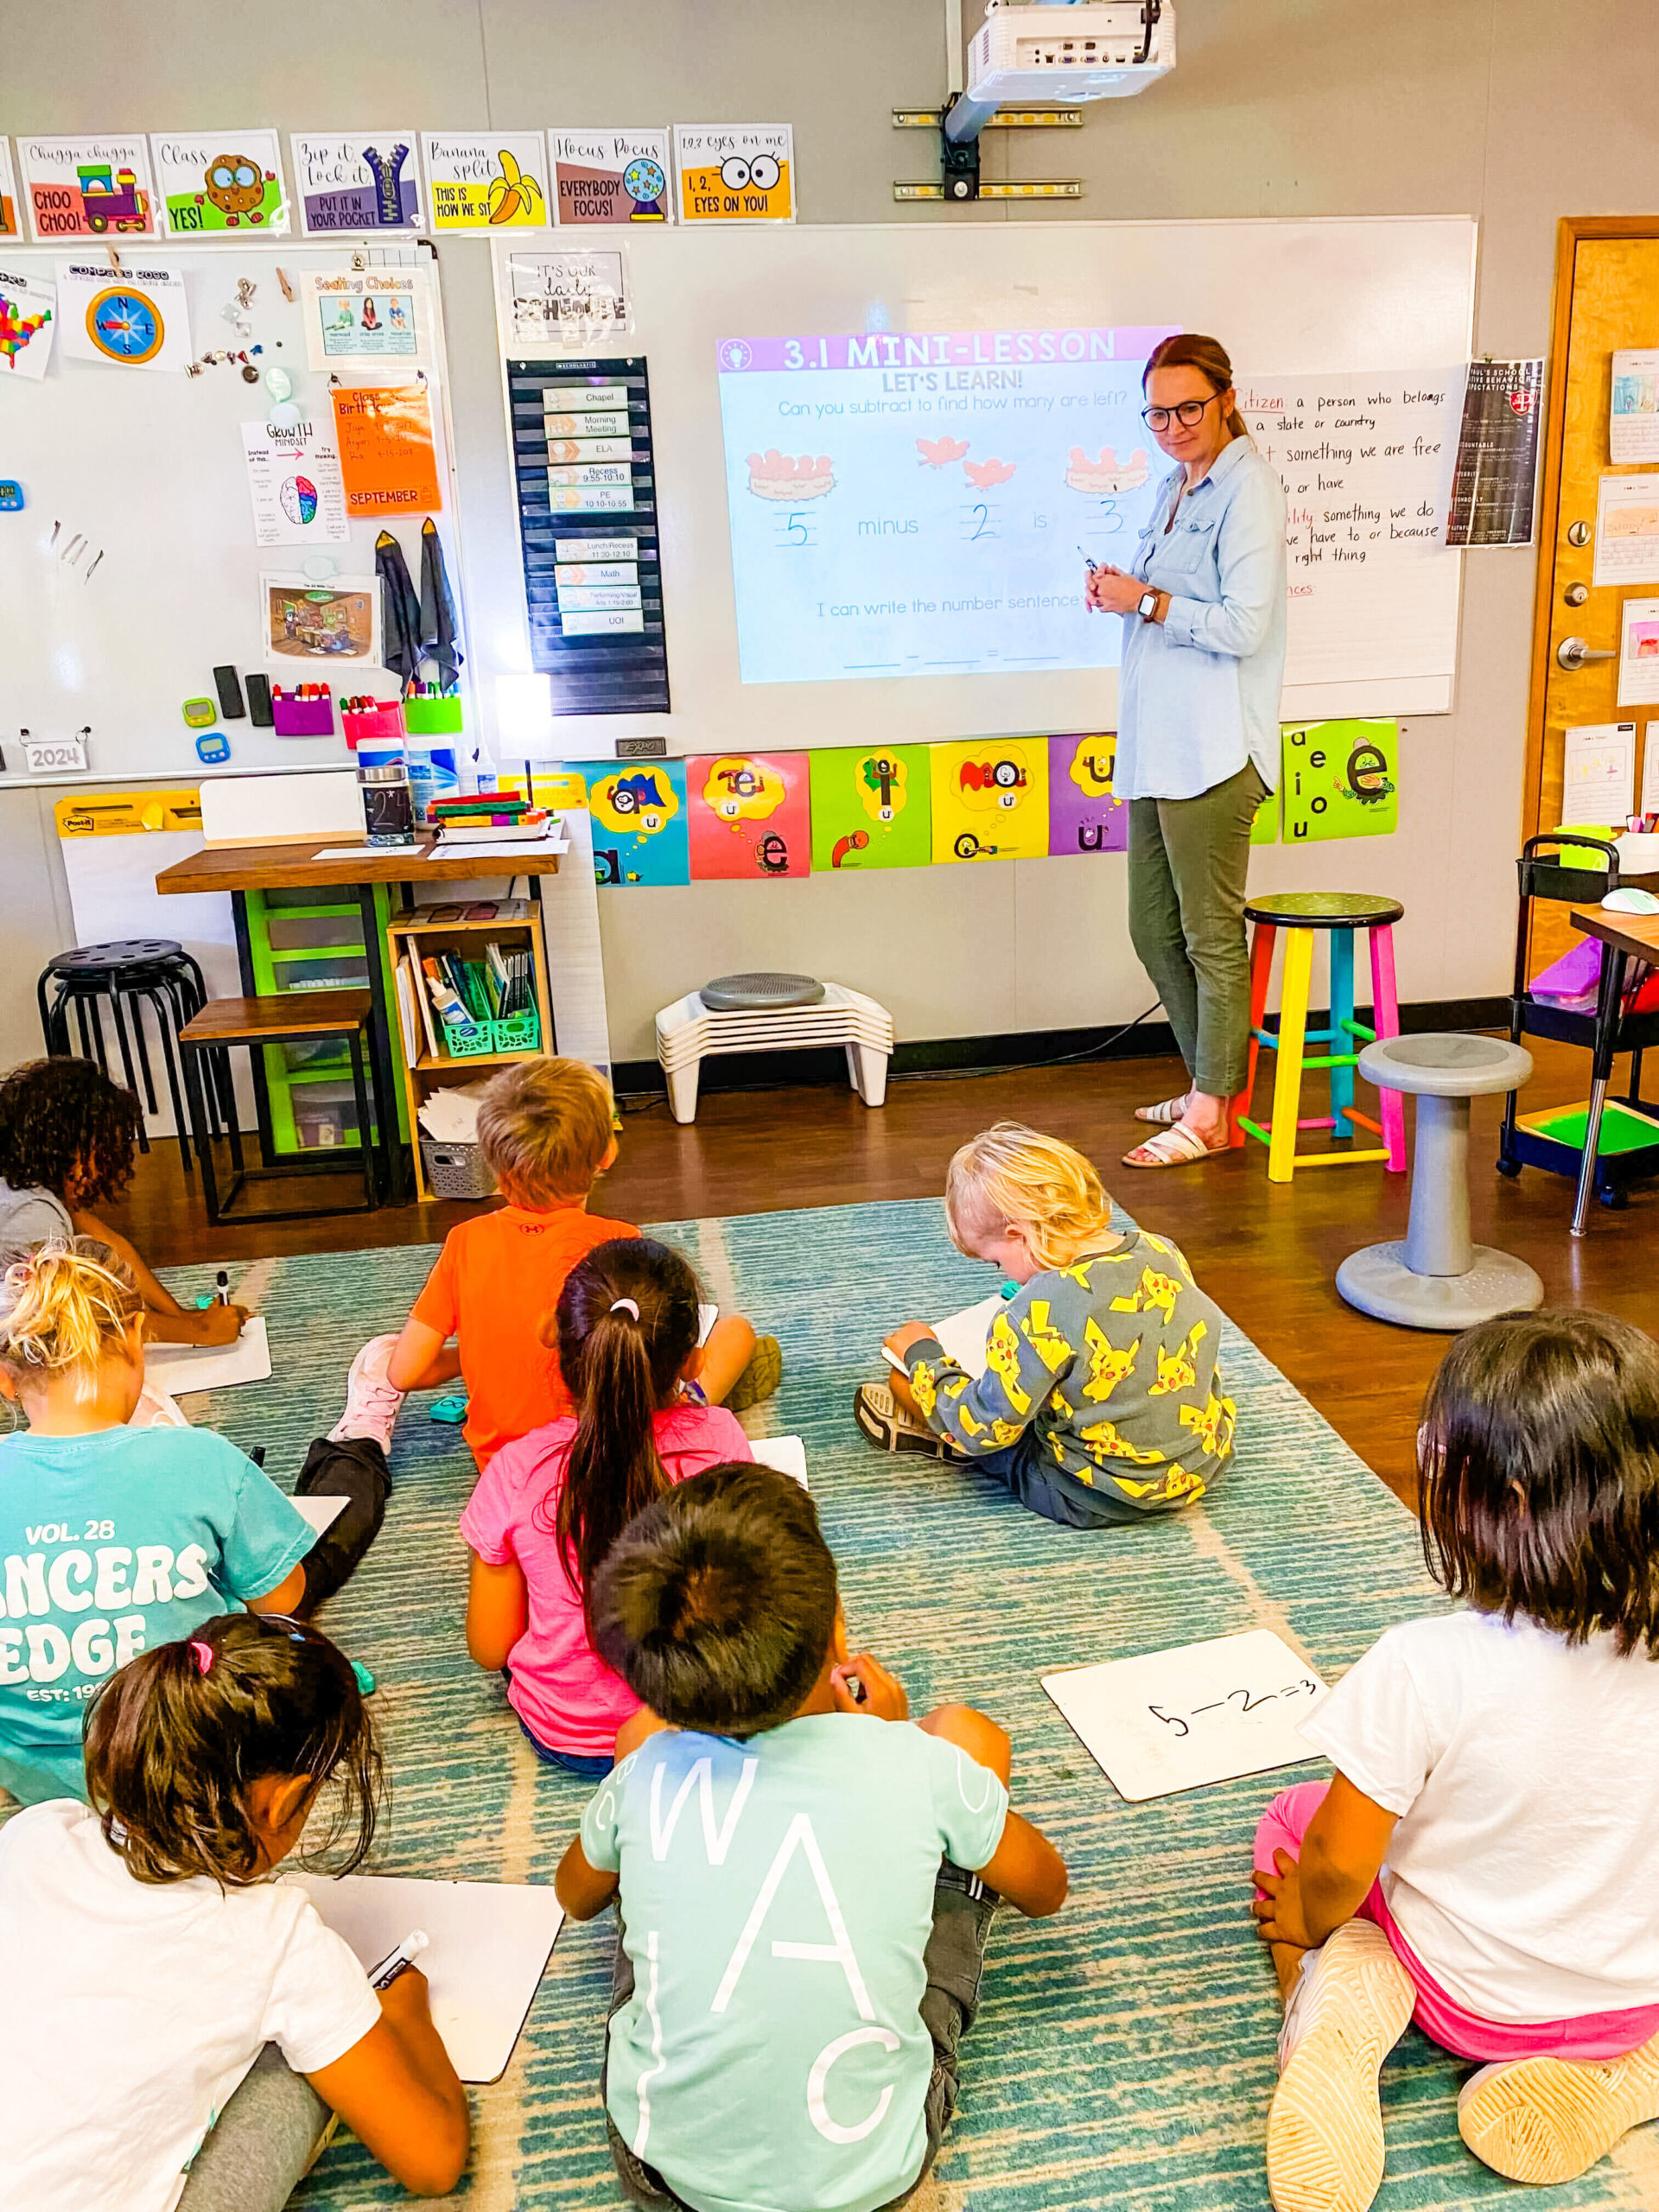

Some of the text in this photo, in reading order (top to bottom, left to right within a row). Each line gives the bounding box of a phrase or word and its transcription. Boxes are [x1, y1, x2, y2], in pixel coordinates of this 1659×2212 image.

[431, 141, 487, 161] Banana
[556, 137, 659, 159] Hocus Pocus
[707, 136, 734, 151] eyes
[743, 135, 760, 146] on
[766, 135, 785, 146] me
[29, 144, 137, 162] Chugga chugga
[161, 143, 207, 165] Class
[302, 143, 327, 165] Zip
[308, 164, 346, 186] Lock
[454, 160, 496, 180] split
[560, 181, 620, 197] EVERYBODY
[699, 175, 711, 192] 2,
[35, 190, 71, 209] CHOO
[320, 196, 361, 211] PUT IT IN
[436, 188, 467, 201] THIS IS
[695, 194, 768, 213] EYES ON YOU!
[169, 207, 203, 228] YES!
[437, 201, 492, 217] HOW WE SIT
[574, 200, 613, 216] FOCUS!
[40, 212, 81, 231] CHOO!
[311, 212, 375, 227] YOUR POCKET
[537, 264, 563, 277] IT'S
[315, 276, 413, 293] Seating Choices
[118, 297, 129, 309] N
[145, 323, 155, 335] E
[123, 344, 131, 355] S
[784, 331, 1116, 370] 3.1 MINI-LESSON
[882, 370, 1022, 393] LET'S LEARN!
[353, 392, 380, 402] Class
[779, 391, 1128, 419] Can you subtract to find how many are left?
[1297, 398, 1304, 408] a
[1319, 397, 1356, 411] person
[1368, 392, 1391, 404] who
[1403, 391, 1446, 407] belongs
[1256, 422, 1264, 430] a
[1277, 417, 1303, 430] state
[1335, 415, 1376, 429] country
[275, 437, 308, 446] MINDSET
[1287, 442, 1352, 464] something
[1360, 447, 1376, 457] we
[1384, 444, 1405, 455] are
[1412, 436, 1441, 456] free
[1298, 484, 1310, 493] or
[1319, 474, 1344, 490] have
[350, 490, 418, 505] SEPTEMBER
[1324, 503, 1381, 523] something
[1390, 508, 1406, 518] we
[1417, 500, 1433, 517] do
[788, 499, 1123, 545] 5 minus 2 is 3
[1310, 527, 1336, 545] have
[1348, 526, 1360, 542] to
[1370, 531, 1382, 539] or
[1390, 523, 1439, 539] because
[1295, 548, 1366, 567] right thing
[601, 569, 620, 578] Math
[817, 602, 823, 616] I
[830, 602, 859, 616] can
[863, 598, 906, 614] write
[912, 598, 936, 613] the
[942, 596, 1001, 611] number
[608, 616, 624, 625] UOI
[626, 741, 655, 753] EXPO
[1291, 731, 1306, 746] a
[31, 748, 79, 766] 2024
[1310, 749, 1326, 768] e
[1295, 772, 1301, 795] i
[1310, 796, 1327, 815] o
[1294, 822, 1307, 837] u
[25, 1520, 115, 1545] VOL. 28
[27, 1690, 70, 1702] EST:
[649, 1758, 758, 1866] W
[709, 1813, 875, 2021] A
[806, 2026, 900, 2145] C
